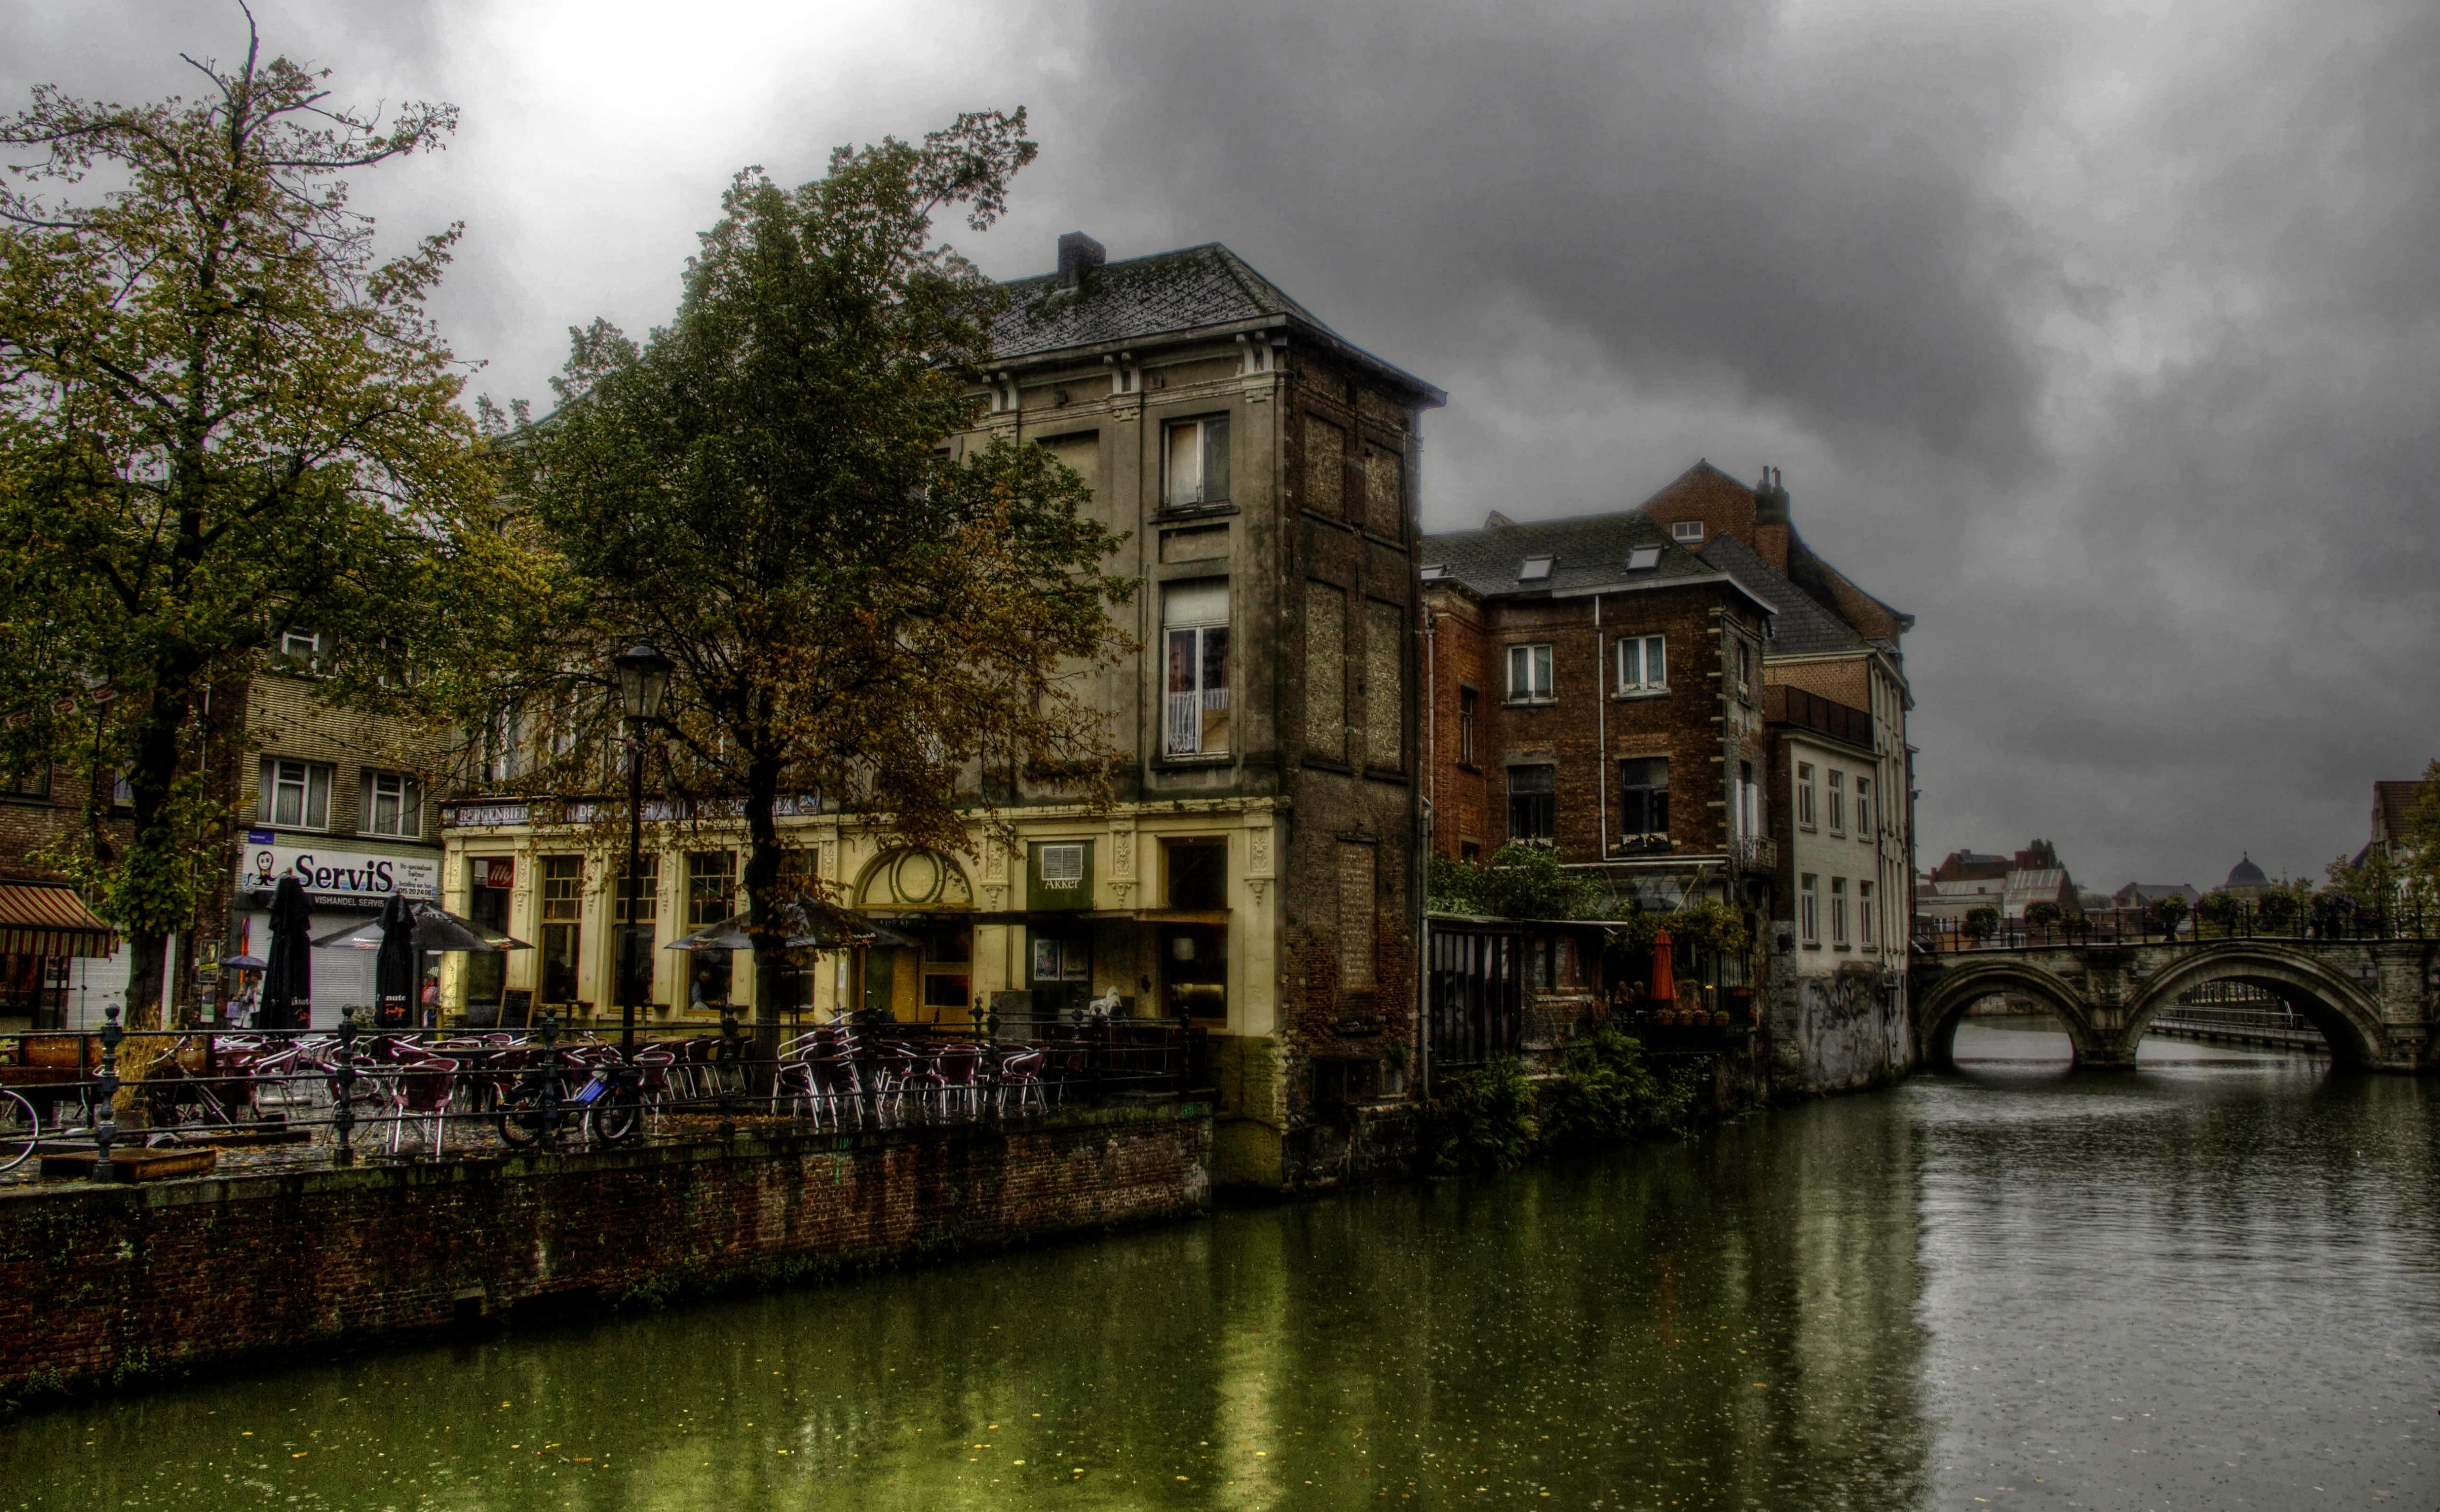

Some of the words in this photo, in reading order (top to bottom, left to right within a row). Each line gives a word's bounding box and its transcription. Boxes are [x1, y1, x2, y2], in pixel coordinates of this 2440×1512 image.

[490, 865, 513, 885] illy
[315, 895, 357, 906] VISHANDEL
[358, 898, 385, 907] SERVIS
